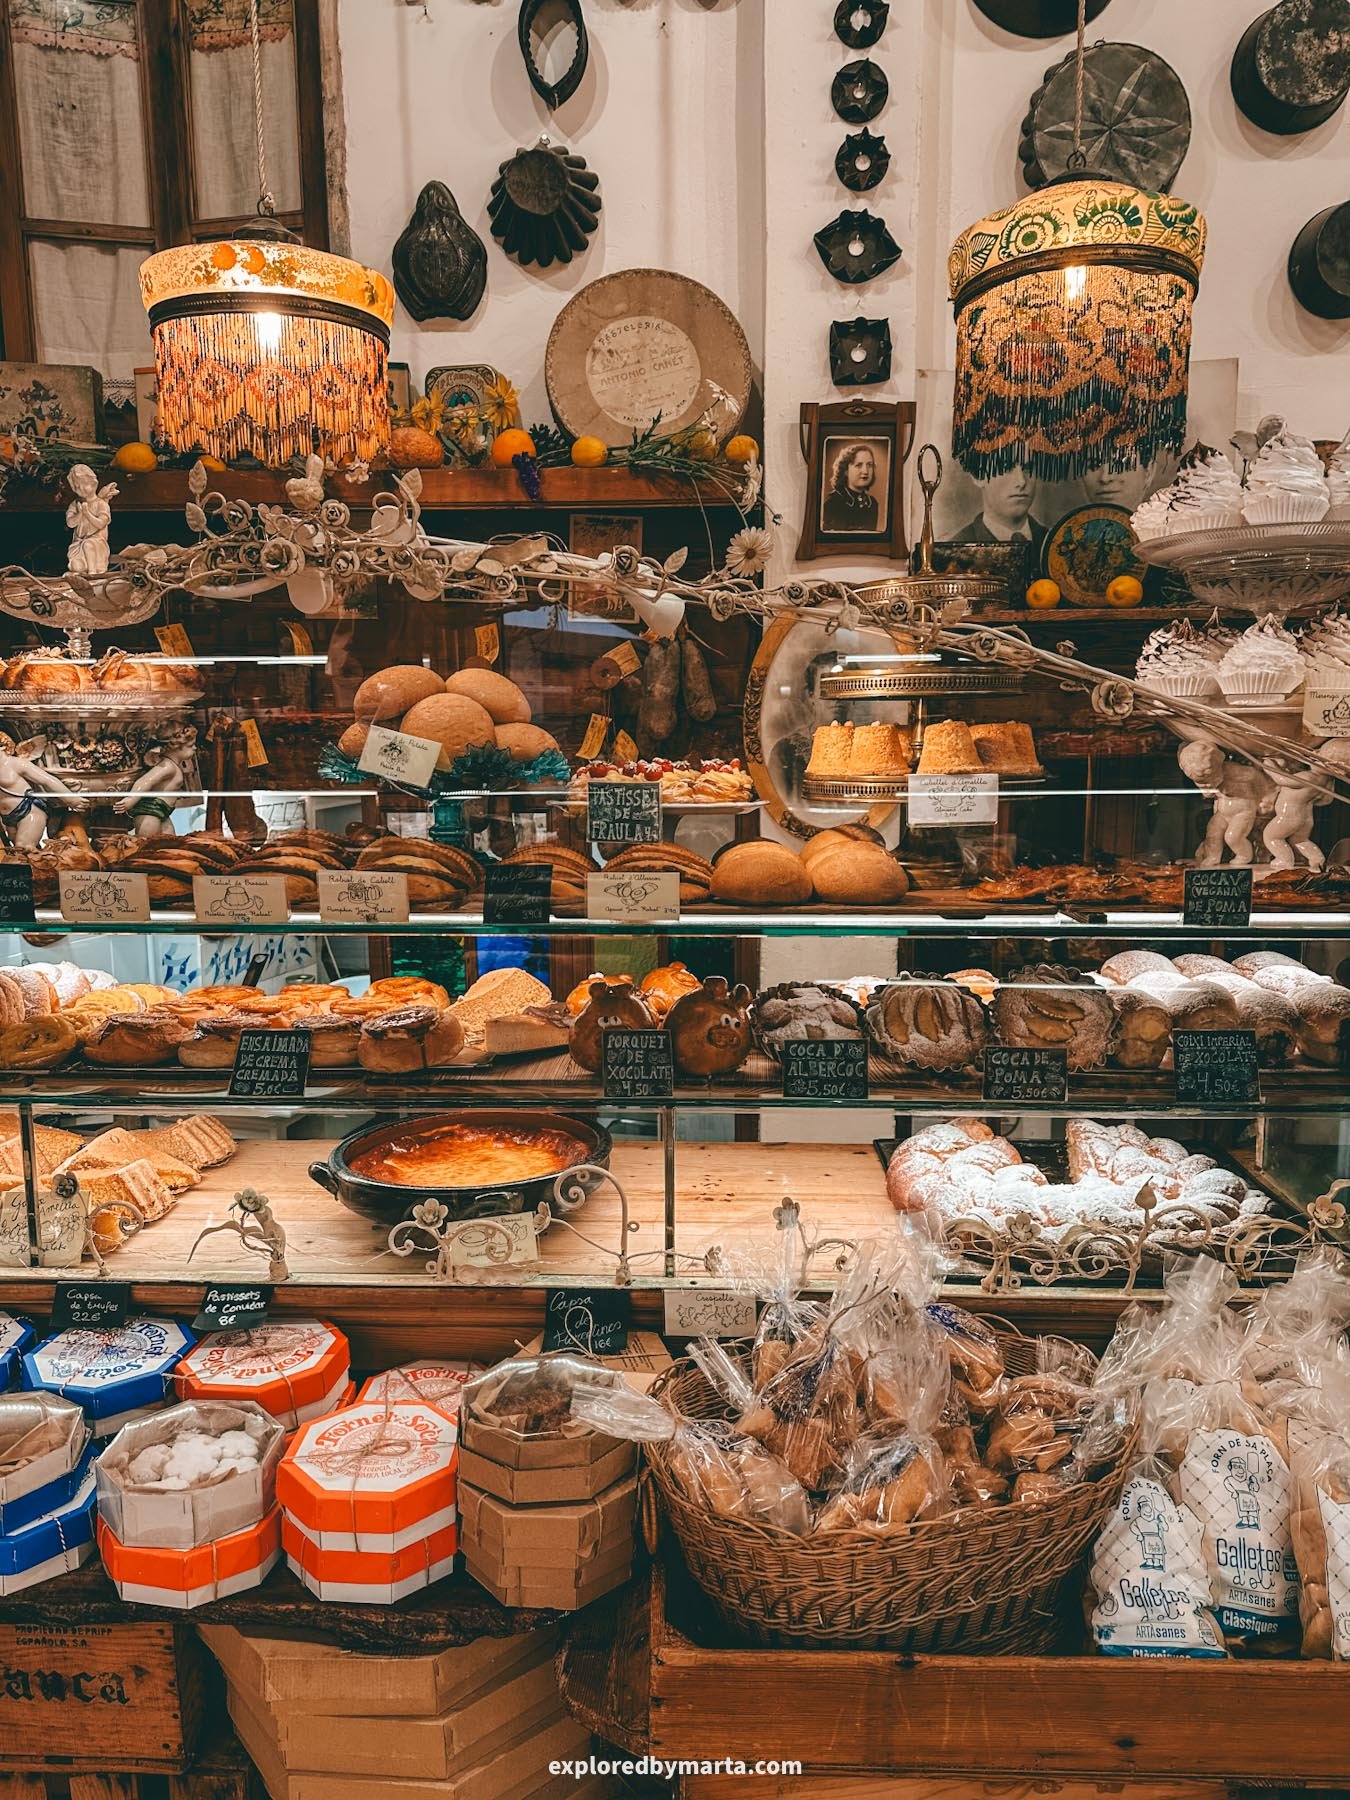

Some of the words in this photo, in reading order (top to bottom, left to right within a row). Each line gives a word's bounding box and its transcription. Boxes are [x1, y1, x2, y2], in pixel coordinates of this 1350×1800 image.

[598, 321, 661, 346] PASTELERIA
[600, 367, 646, 387] ANTONIO
[652, 355, 684, 372] CANET
[614, 807, 631, 820] DE
[1188, 900, 1203, 912] DE
[1207, 898, 1247, 913] POMA
[607, 1034, 666, 1049] PORQUET
[626, 1049, 644, 1065] DE
[789, 1043, 826, 1057] COCA
[1178, 1053, 1192, 1063] DE
[1194, 1050, 1257, 1064] XOCOLATE
[240, 1053, 255, 1067] DE
[255, 1055, 298, 1069] CREMA
[991, 1051, 1030, 1066] COCA
[1034, 1051, 1049, 1065] DE
[235, 1069, 299, 1082] CREMADA
[607, 1065, 673, 1080] XOCOLATE
[787, 1060, 865, 1078] ALBERCOC
[993, 1067, 1042, 1084] POMA
[66, 1288, 102, 1302] Capsa
[206, 1289, 261, 1302] Pastissets
[549, 1291, 594, 1312] Capsa
[70, 1301, 81, 1310] de
[204, 1303, 217, 1314] de
[221, 1301, 266, 1314] Convidar
[71, 1311, 101, 1322] 22€
[218, 1314, 237, 1326] 8€
[574, 1309, 589, 1329] de
[130, 1322, 169, 1358] Fornet
[594, 1337, 612, 1349] 16€
[83, 1358, 144, 1380] Soca
[403, 1367, 476, 1384] Forne
[314, 1411, 394, 1448] Fornet
[408, 1414, 444, 1453] Soca
[1211, 1446, 1227, 1474] FORN
[1228, 1438, 1241, 1449] DE
[1245, 1440, 1258, 1450] SA
[1259, 1448, 1274, 1483] PLAÇA
[1122, 1490, 1132, 1521] FORN
[1130, 1481, 1143, 1489] DE
[1146, 1482, 1160, 1493] SA
[1216, 1536, 1281, 1573] Galletes
[1222, 1609, 1279, 1635] Clàssiques
[1136, 1622, 1187, 1640] ARTÀsanes
[0, 1665, 130, 1705] anca
